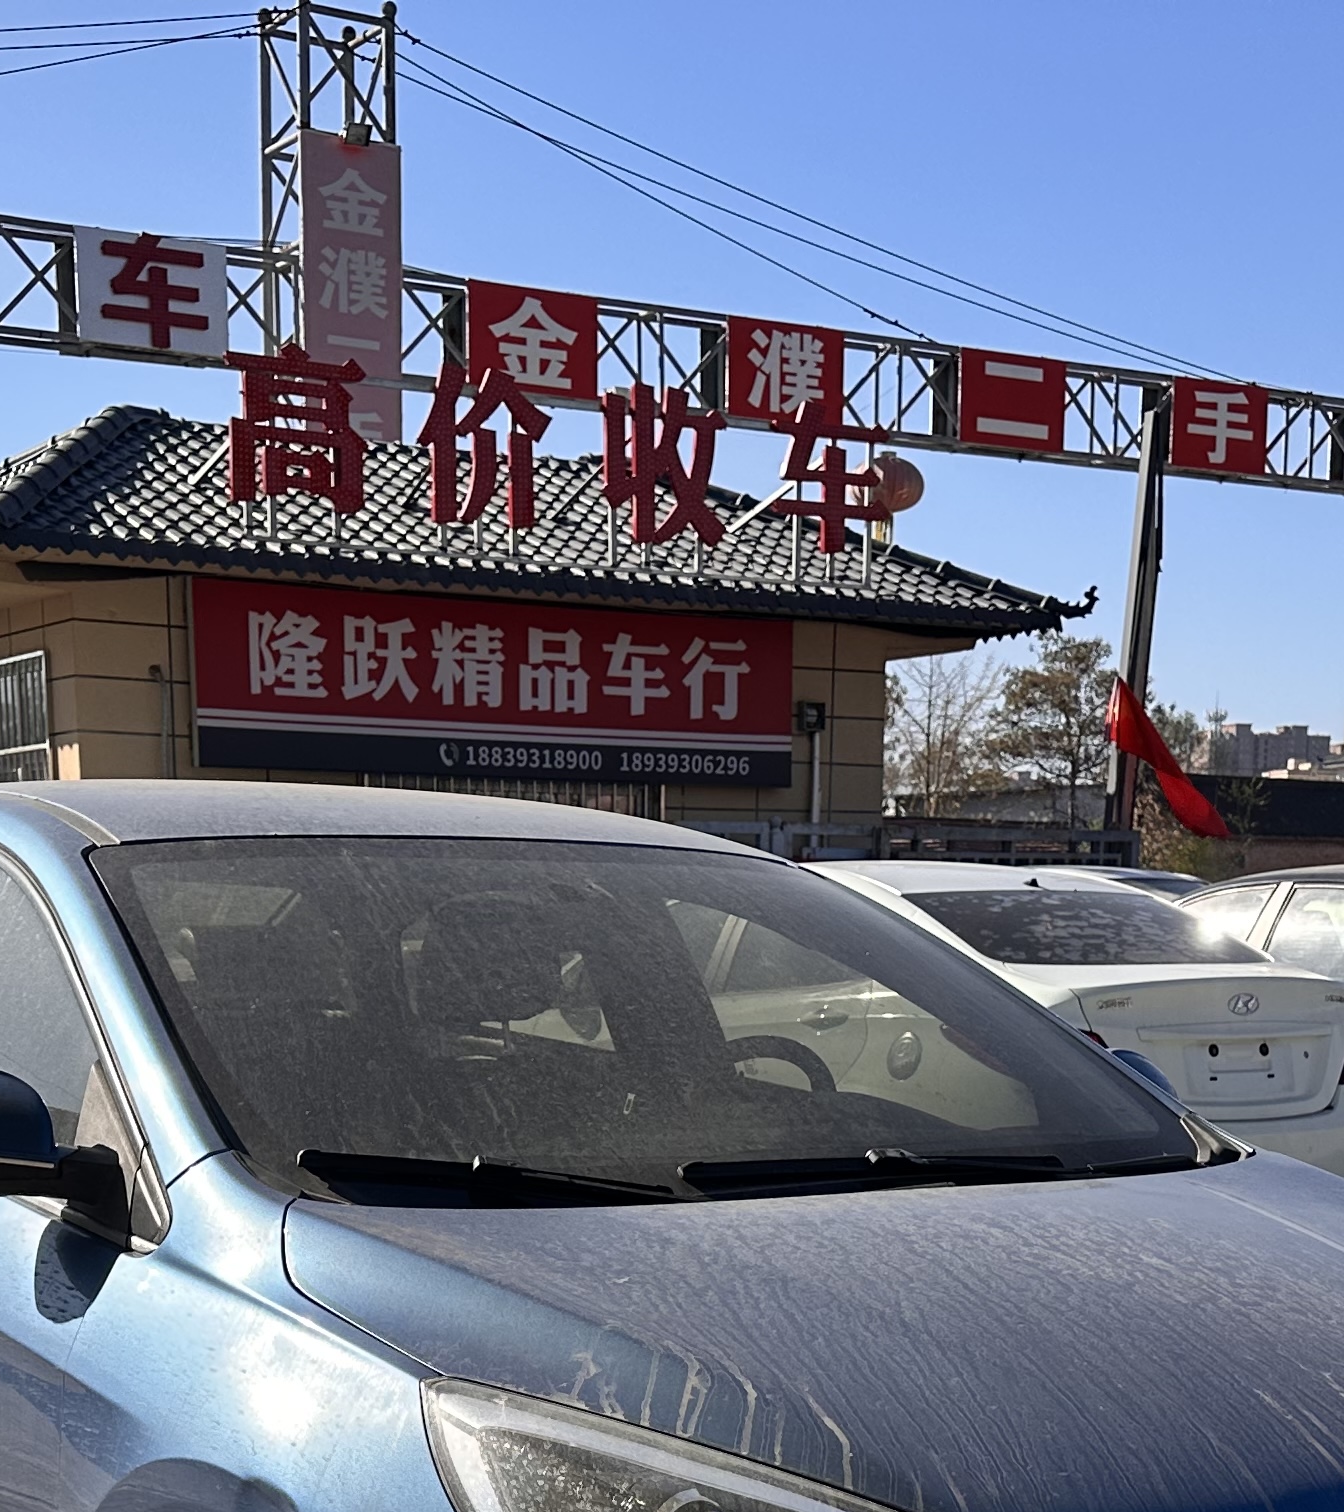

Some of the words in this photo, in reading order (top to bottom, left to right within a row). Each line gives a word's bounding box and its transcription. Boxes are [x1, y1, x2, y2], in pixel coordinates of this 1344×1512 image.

[224, 343, 892, 554] 高价收车
[247, 609, 751, 722] 隆跃精品车行
[465, 745, 603, 771] 18839318900
[618, 751, 751, 776] 18939306296
